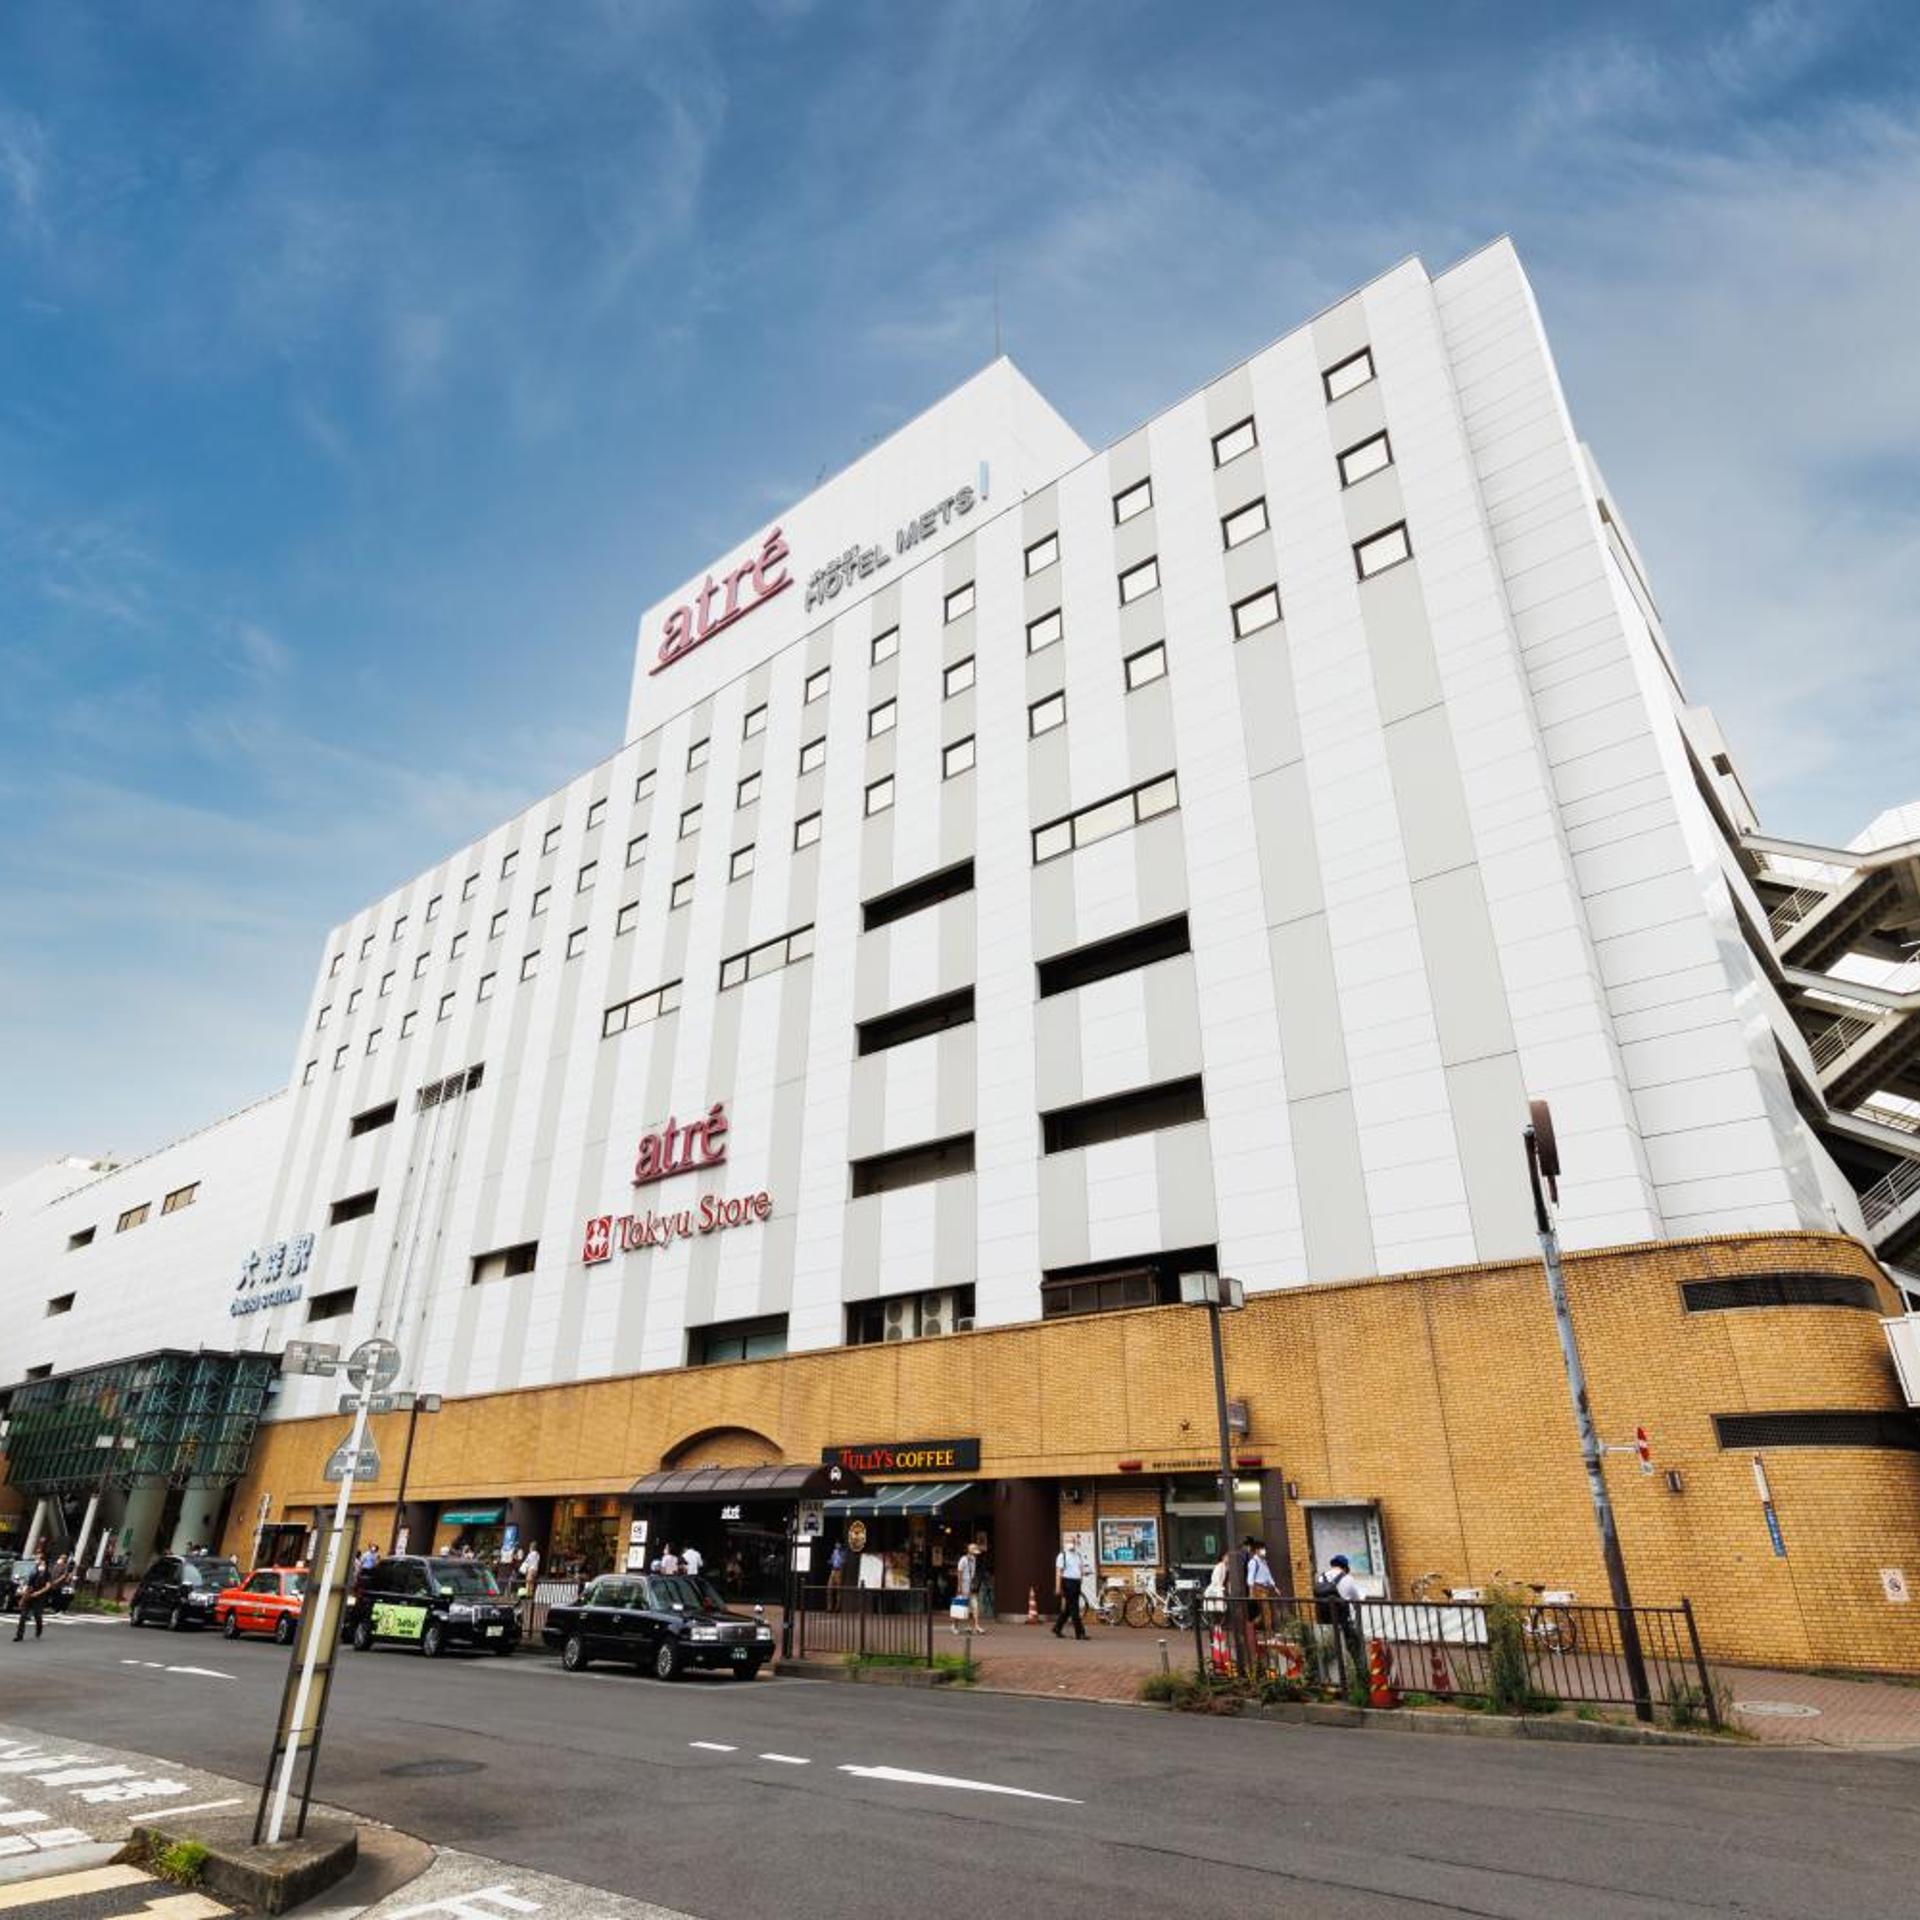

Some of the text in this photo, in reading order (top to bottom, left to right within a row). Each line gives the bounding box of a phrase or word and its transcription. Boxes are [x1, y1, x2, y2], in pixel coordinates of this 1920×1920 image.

[656, 526, 791, 666] atré
[804, 544, 892, 614] HOTEL
[634, 1102, 729, 1179] atré
[617, 1191, 773, 1253] Tokyu Store
[896, 1450, 955, 1468] COFFEE
